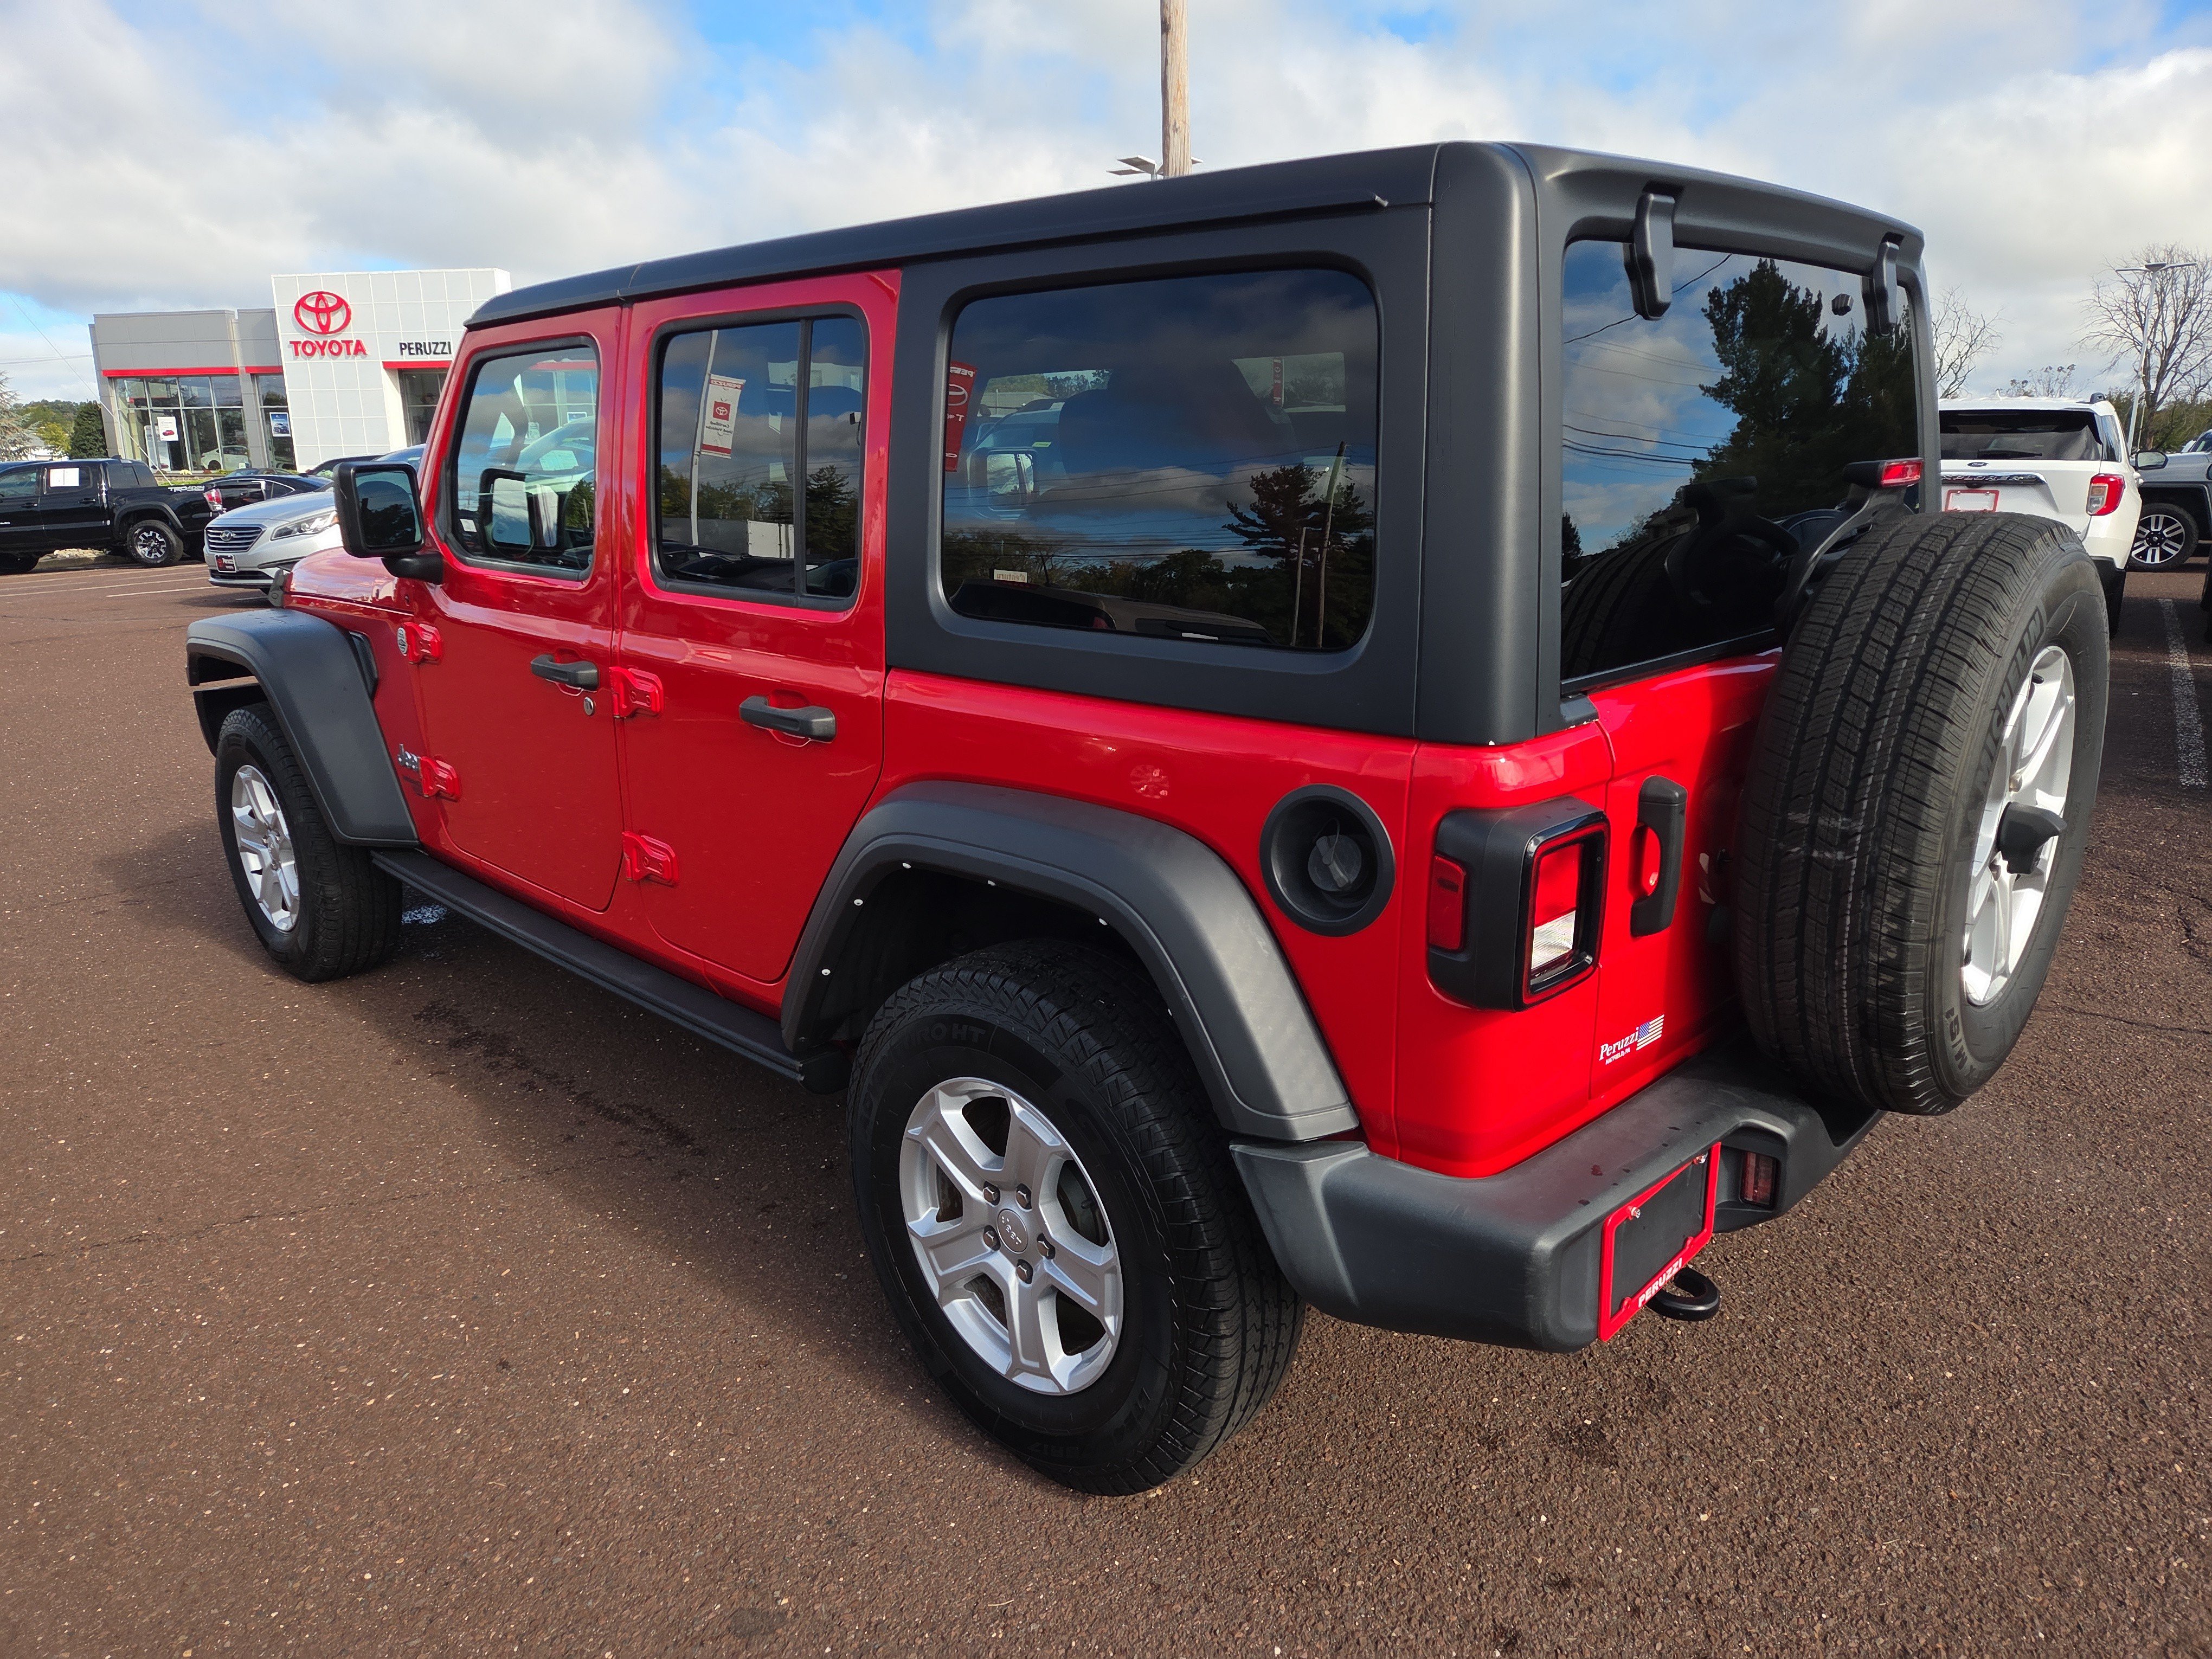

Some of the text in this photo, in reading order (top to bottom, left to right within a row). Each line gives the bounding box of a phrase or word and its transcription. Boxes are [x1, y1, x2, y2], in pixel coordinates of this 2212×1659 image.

[289, 339, 368, 357] TOYOTA
[399, 341, 452, 356] PERUZZI
[1972, 608, 2044, 795] MICHELIN
[952, 1023, 987, 1044] HT
[1599, 1026, 1639, 1061] Peruzzi
[1638, 1257, 1682, 1308] PERUZZI
